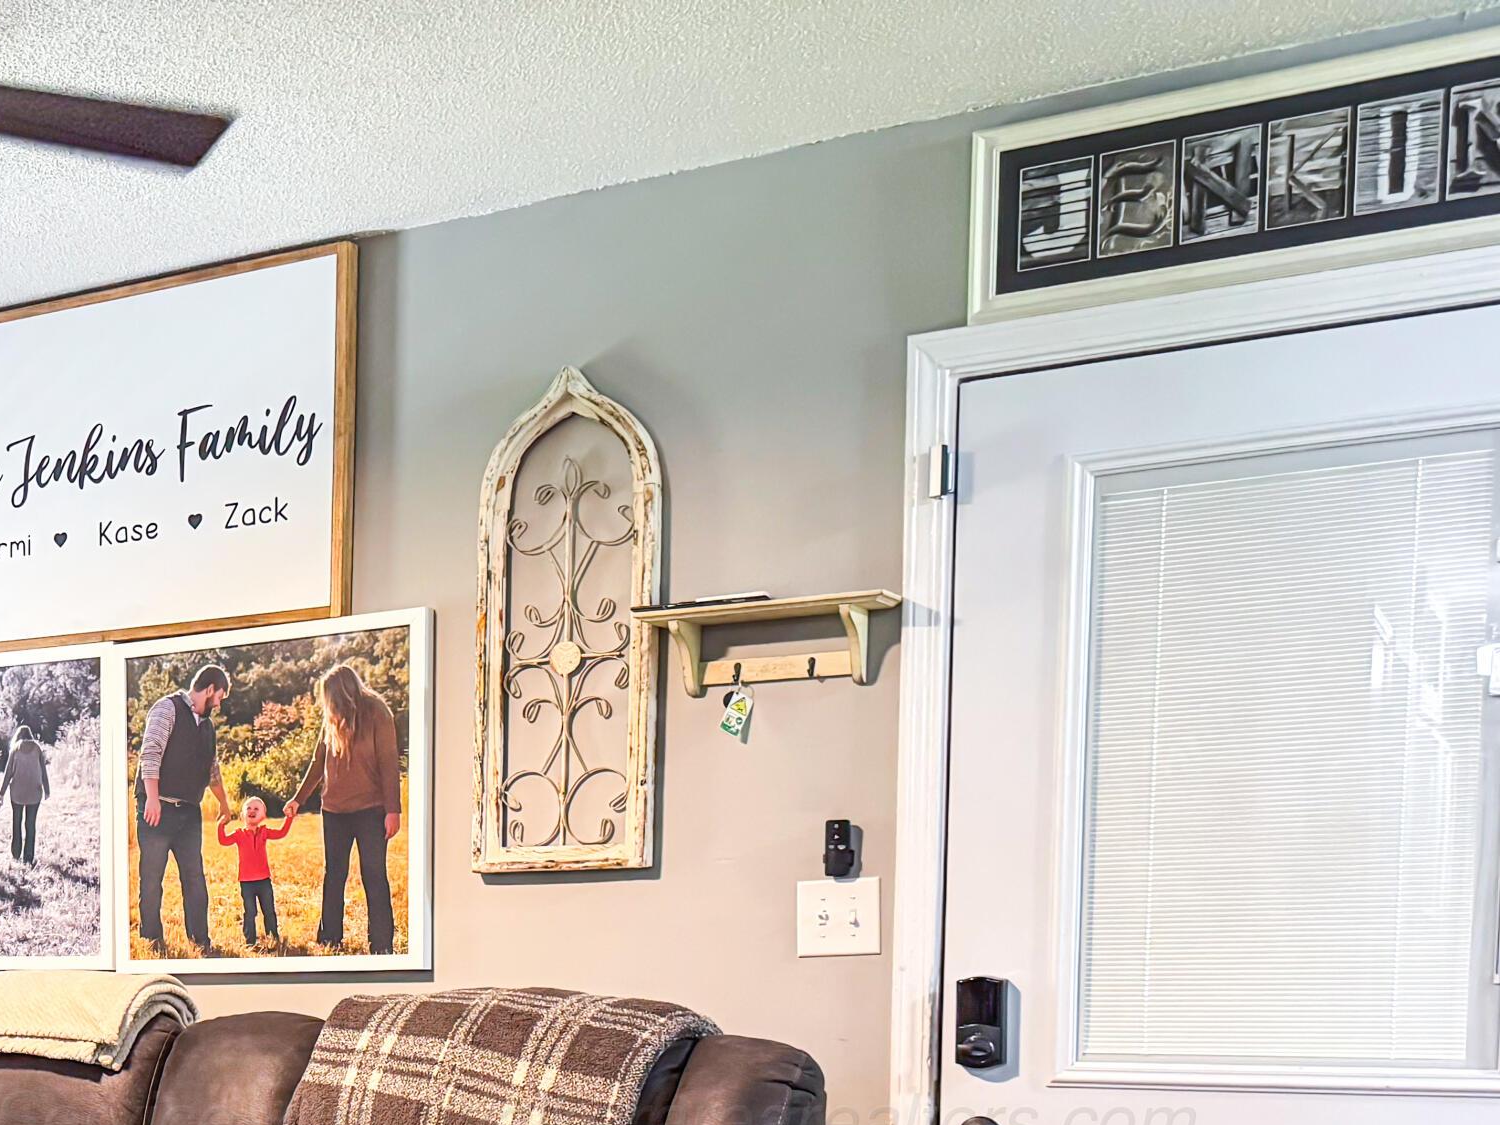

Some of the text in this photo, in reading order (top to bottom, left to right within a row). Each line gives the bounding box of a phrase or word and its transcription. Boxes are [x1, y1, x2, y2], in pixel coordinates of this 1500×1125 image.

[6, 423, 165, 509] Jenkins
[176, 395, 324, 483] Family
[99, 521, 160, 546] Kase
[224, 496, 289, 530] Zack
